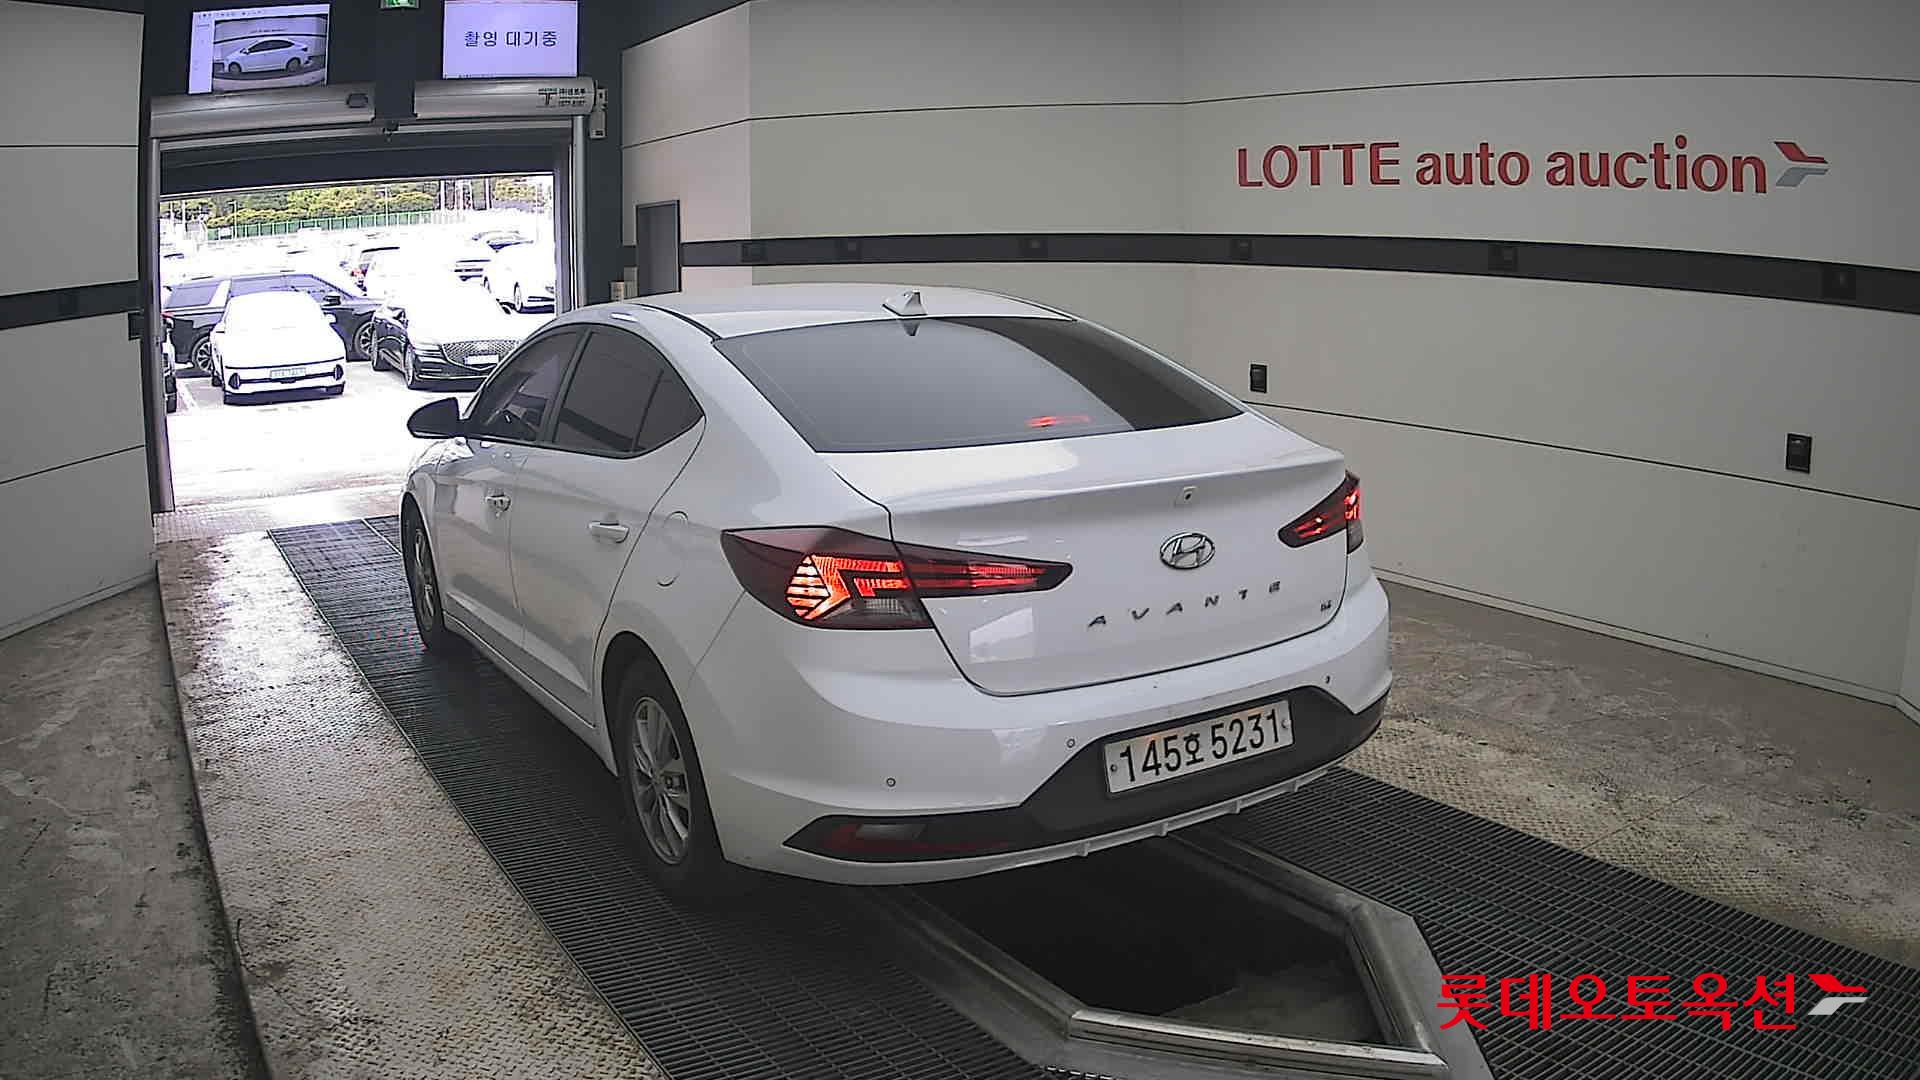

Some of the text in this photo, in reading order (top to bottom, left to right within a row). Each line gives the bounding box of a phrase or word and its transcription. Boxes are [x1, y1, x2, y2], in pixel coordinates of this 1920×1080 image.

[464, 31, 558, 47] 촬영 대기중
[1238, 135, 1768, 194] LOTTE auto auction
[1087, 581, 1282, 628] AVANTE
[1119, 708, 1280, 782] 145호 5231
